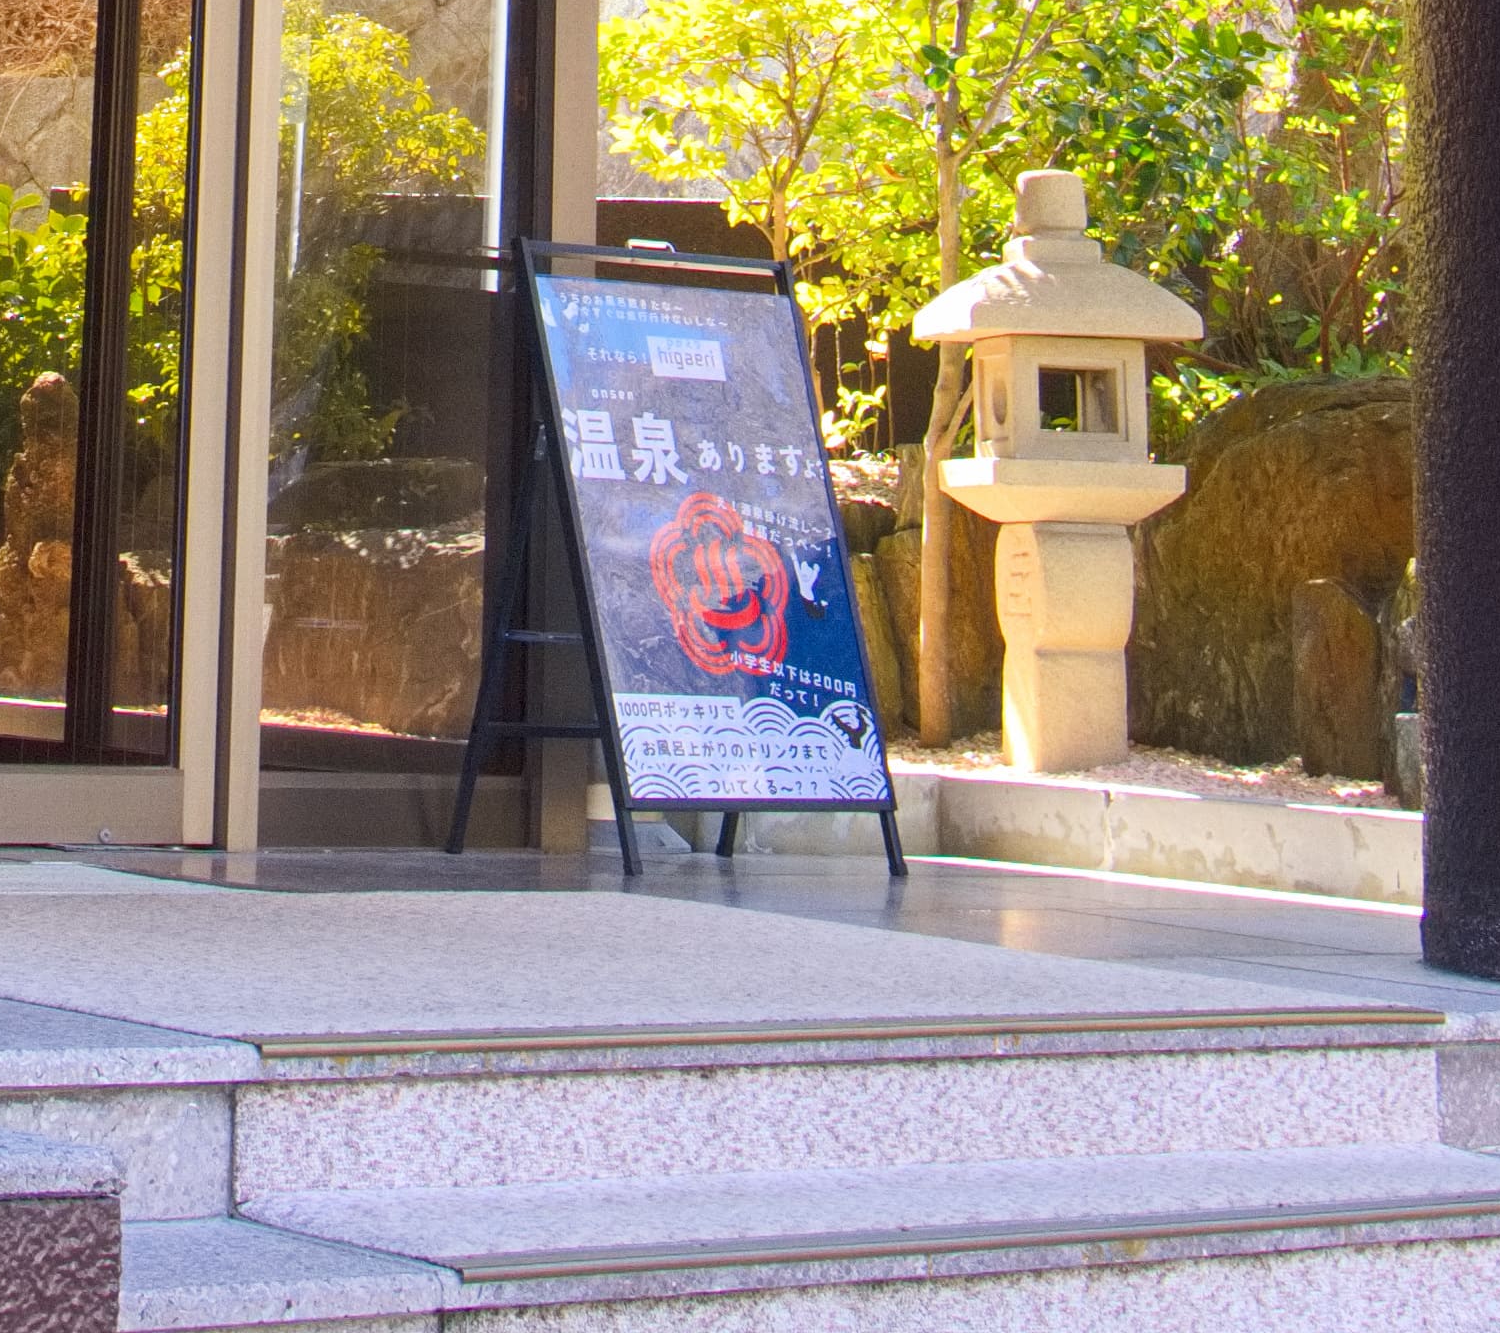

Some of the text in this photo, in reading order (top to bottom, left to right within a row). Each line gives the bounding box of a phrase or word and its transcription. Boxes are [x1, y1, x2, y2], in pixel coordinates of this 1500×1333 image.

[657, 345, 716, 370] higaeri
[592, 387, 634, 401] onsen
[730, 651, 857, 699] 小学生以下は200円
[769, 682, 819, 708] だって！
[618, 701, 736, 720] 1000円ポッキリで
[642, 740, 828, 760] お風呂上がりのドリンクまで
